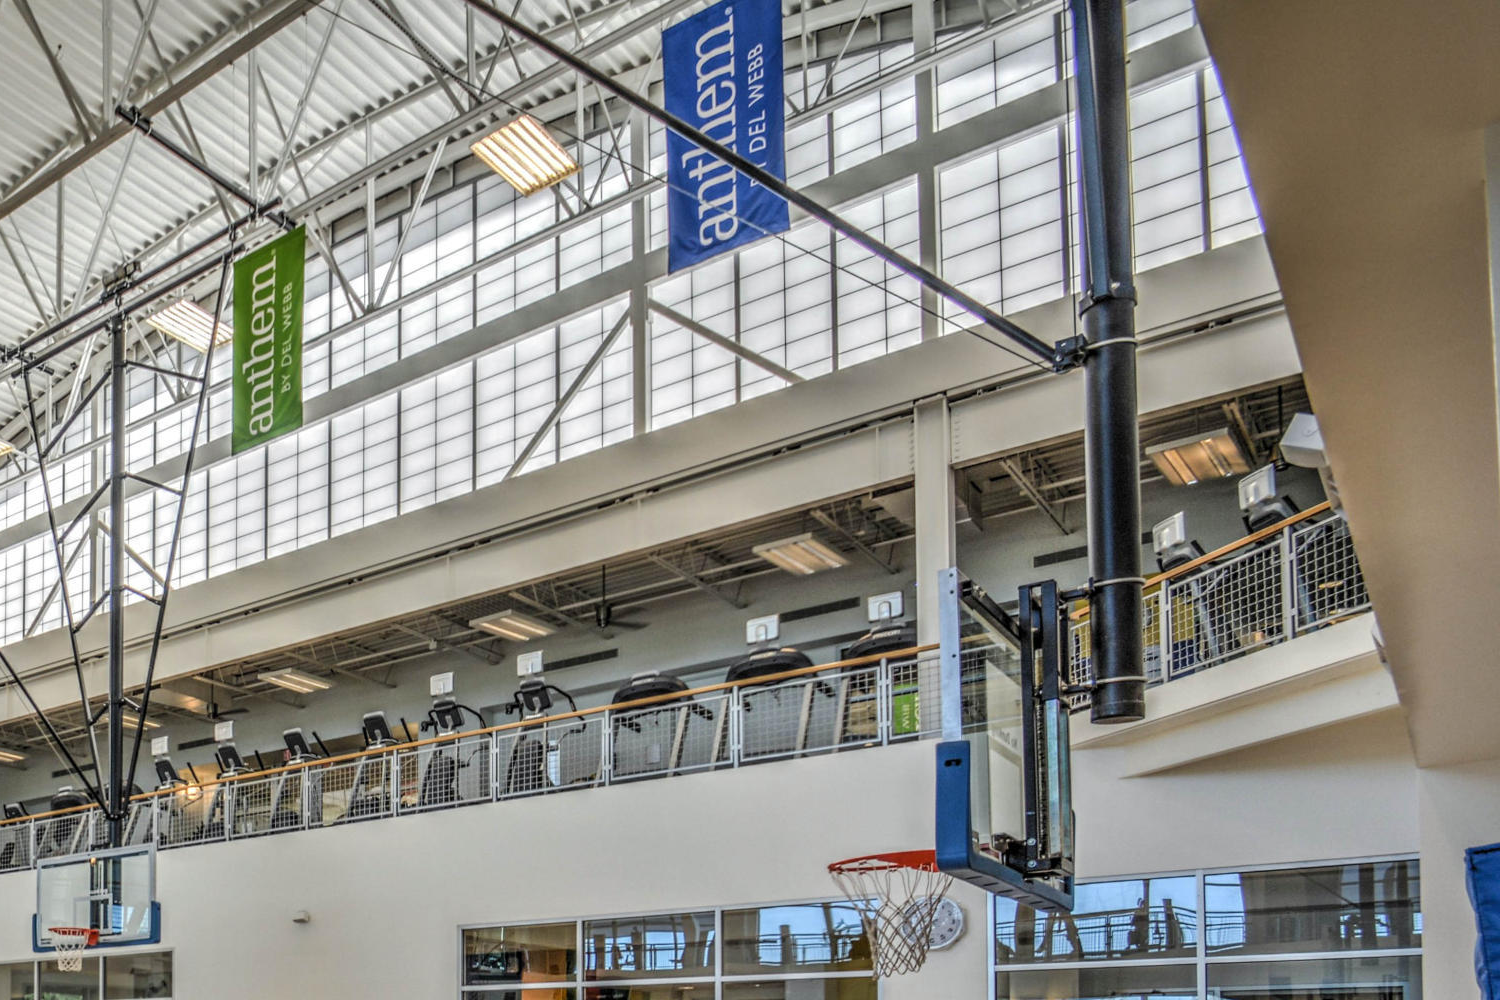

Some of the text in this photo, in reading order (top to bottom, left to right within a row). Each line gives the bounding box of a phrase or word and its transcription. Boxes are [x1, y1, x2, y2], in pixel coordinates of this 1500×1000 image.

[747, 43, 765, 109] WEBB
[748, 109, 767, 154] DEL
[280, 281, 293, 394] BY DEL WEBB
